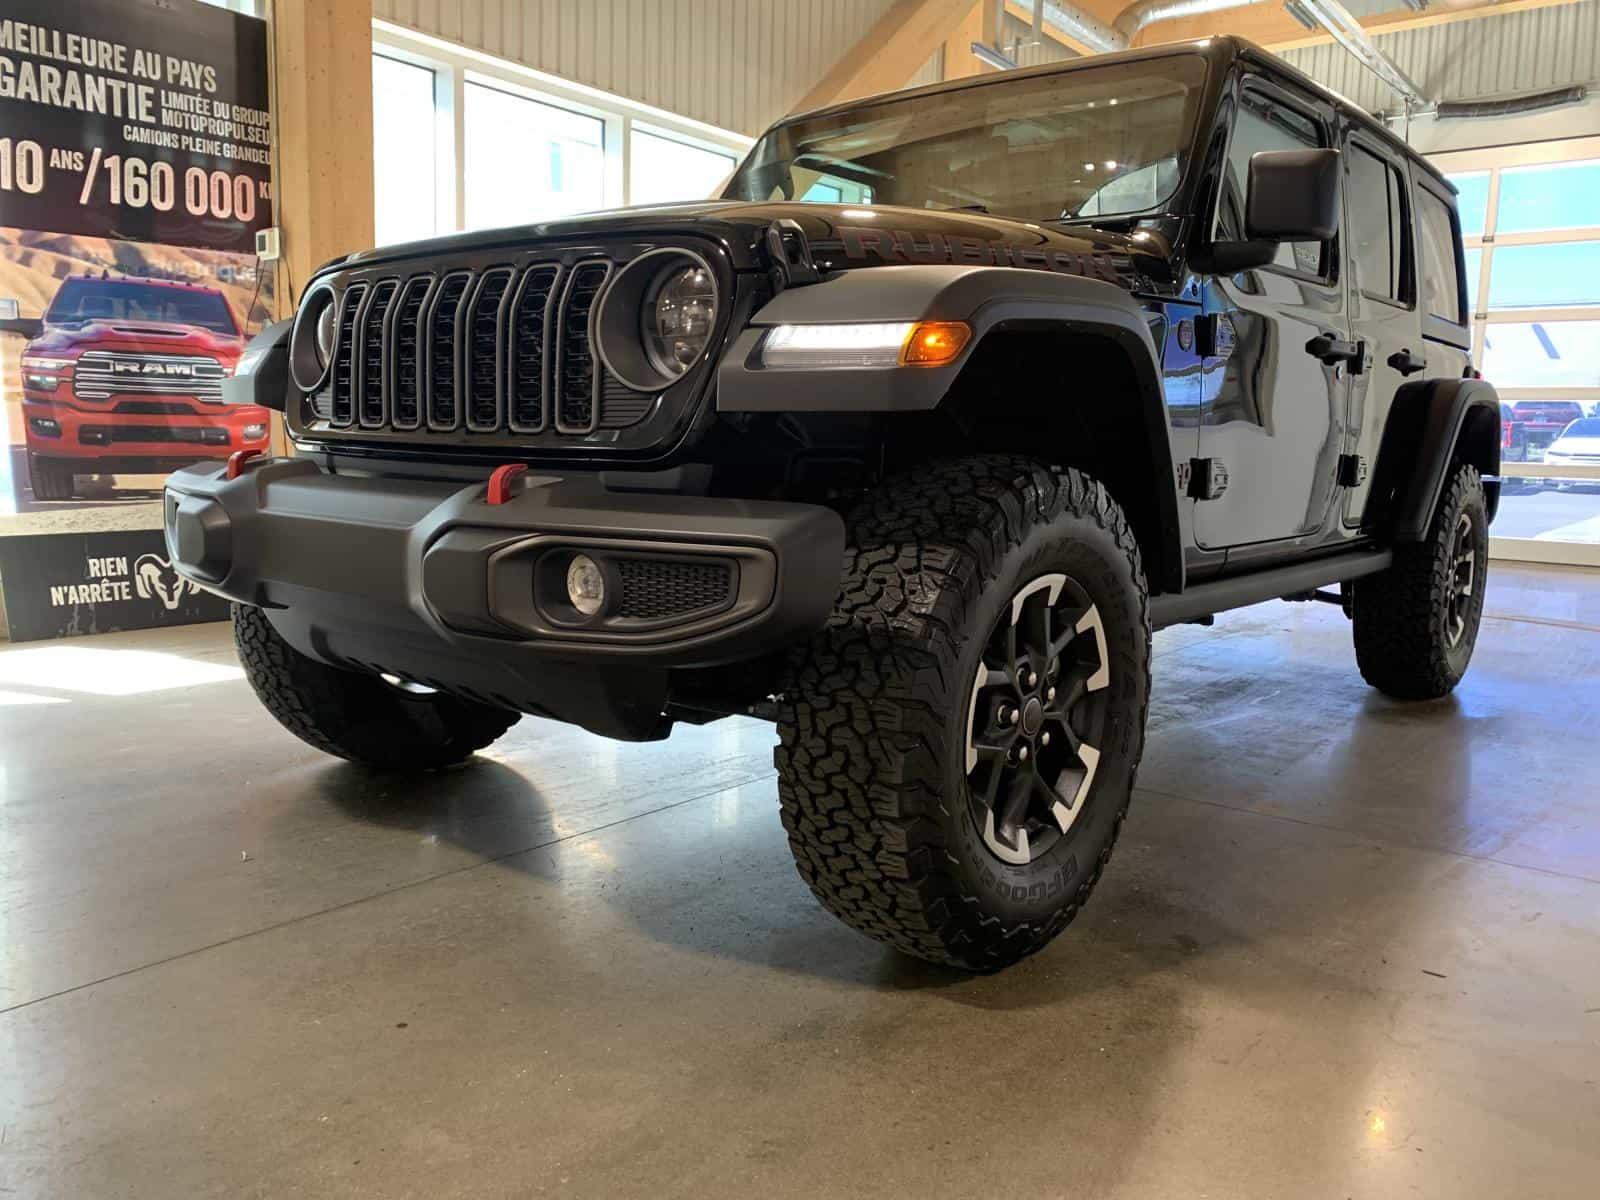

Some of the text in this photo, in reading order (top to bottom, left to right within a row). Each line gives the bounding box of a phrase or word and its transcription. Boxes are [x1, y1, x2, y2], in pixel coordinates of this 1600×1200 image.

[132, 50, 161, 80] AU
[166, 61, 216, 92] PAYS
[0, 55, 156, 124] GARANTIE
[160, 90, 211, 116] LIMITÉE
[213, 101, 230, 120] DU
[123, 124, 179, 149] CAMIONS
[181, 135, 221, 156] PLEINE
[0, 138, 44, 194] 10
[50, 148, 84, 172] ANS
[185, 167, 255, 222] 000
[836, 227, 1122, 284] RUBICON
[115, 362, 192, 375] RAM
[88, 556, 128, 578] RIEN
[51, 579, 132, 606] N'ARRÊTE
